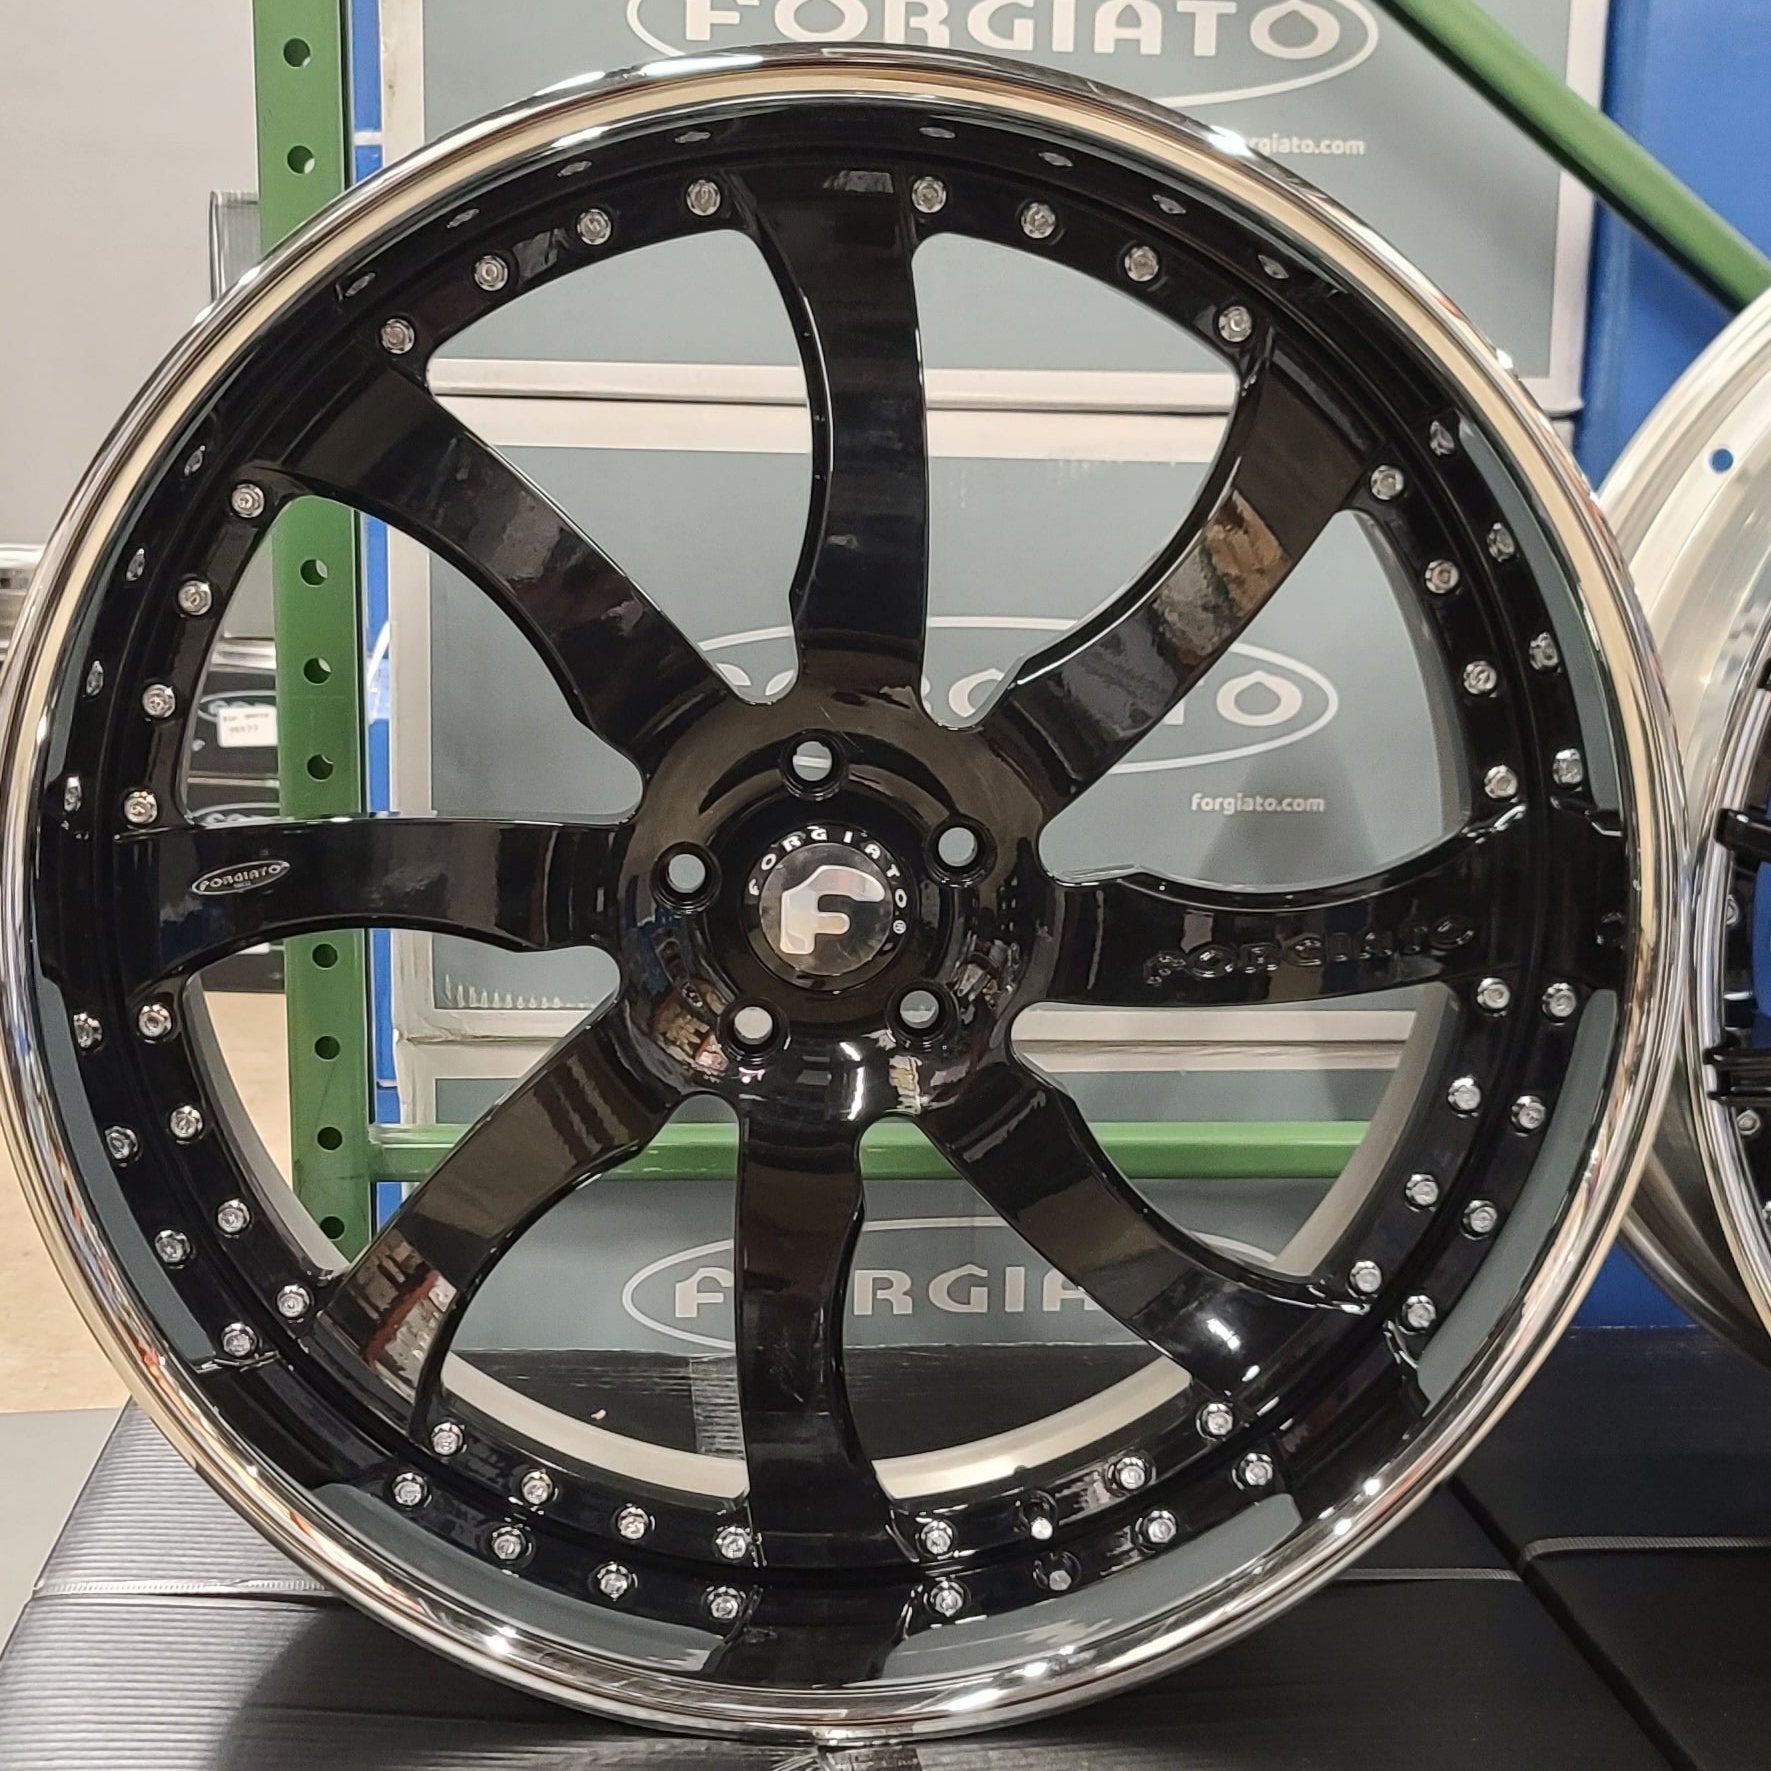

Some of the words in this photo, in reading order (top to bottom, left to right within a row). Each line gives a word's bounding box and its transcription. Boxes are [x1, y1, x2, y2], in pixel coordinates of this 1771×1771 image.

[685, 0, 1341, 60] FORGIATO
[1249, 132, 1366, 156] rgiato.com
[1191, 792, 1325, 815] forgiato.com
[749, 828, 907, 909] FORGIATO
